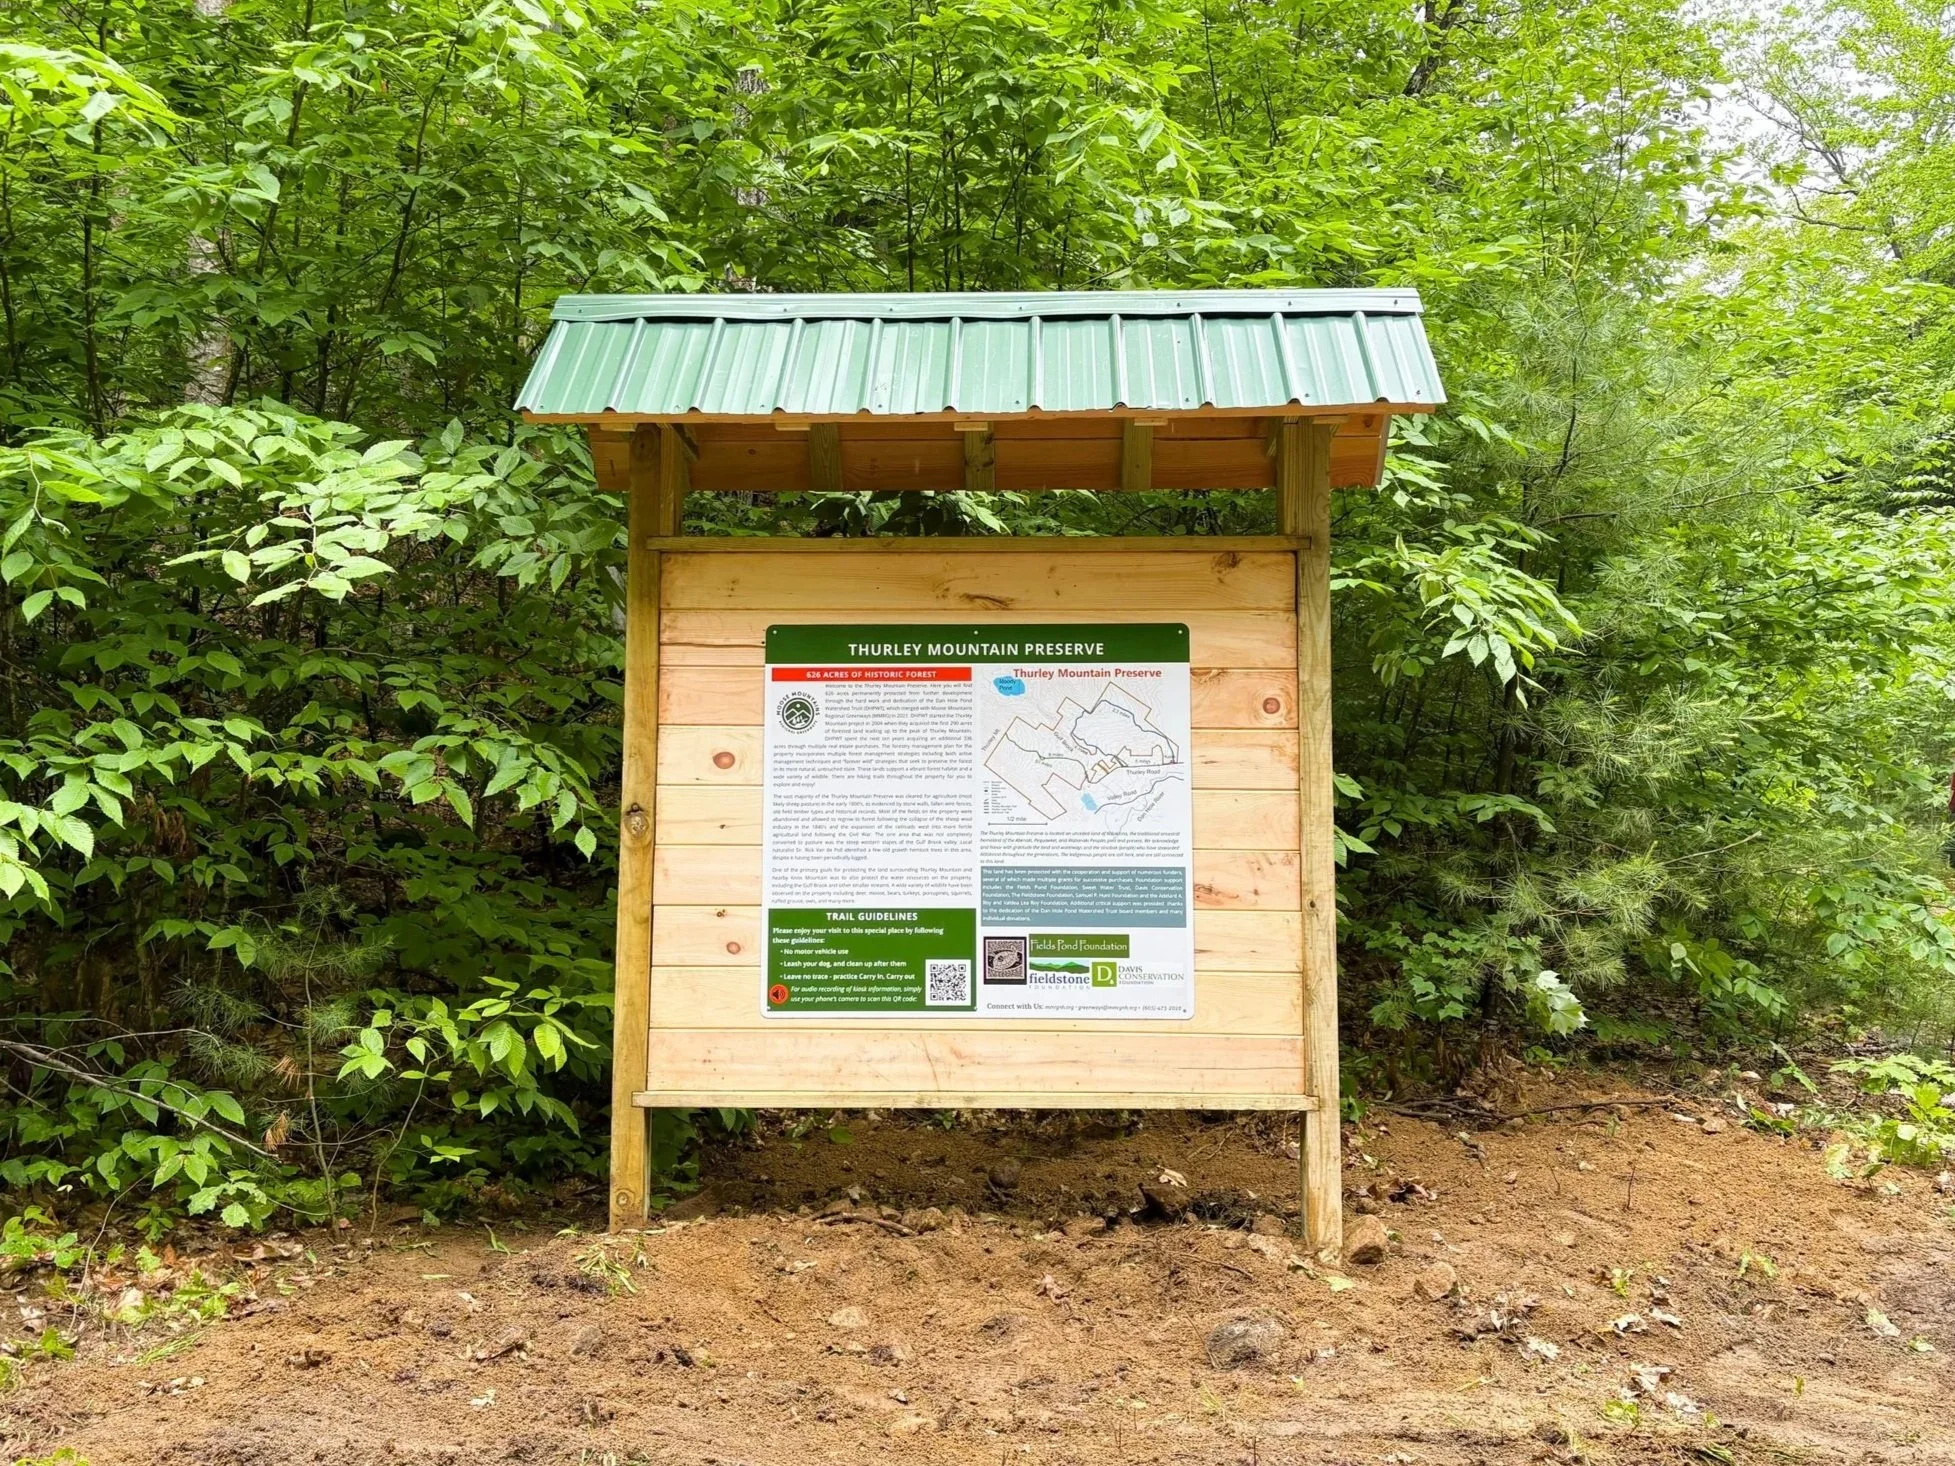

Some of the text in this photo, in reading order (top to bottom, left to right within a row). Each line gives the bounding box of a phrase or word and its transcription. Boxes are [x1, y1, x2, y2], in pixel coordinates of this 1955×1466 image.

[848, 643, 1104, 656] THURLEY MOUNTAIN PRESERVE
[1013, 669, 1161, 679] Thurley Mountain Preserve
[776, 691, 820, 716] MOOSE MOUNTAINS
[826, 912, 918, 921] TRAIL GUIDELINES
[794, 928, 812, 936] enjoy
[864, 928, 887, 936] special
[887, 928, 905, 936] place
[905, 928, 914, 936] by
[914, 928, 944, 936] following
[1030, 939, 1127, 951] Fields Pond Foundation
[1029, 973, 1090, 984] fieldstone
